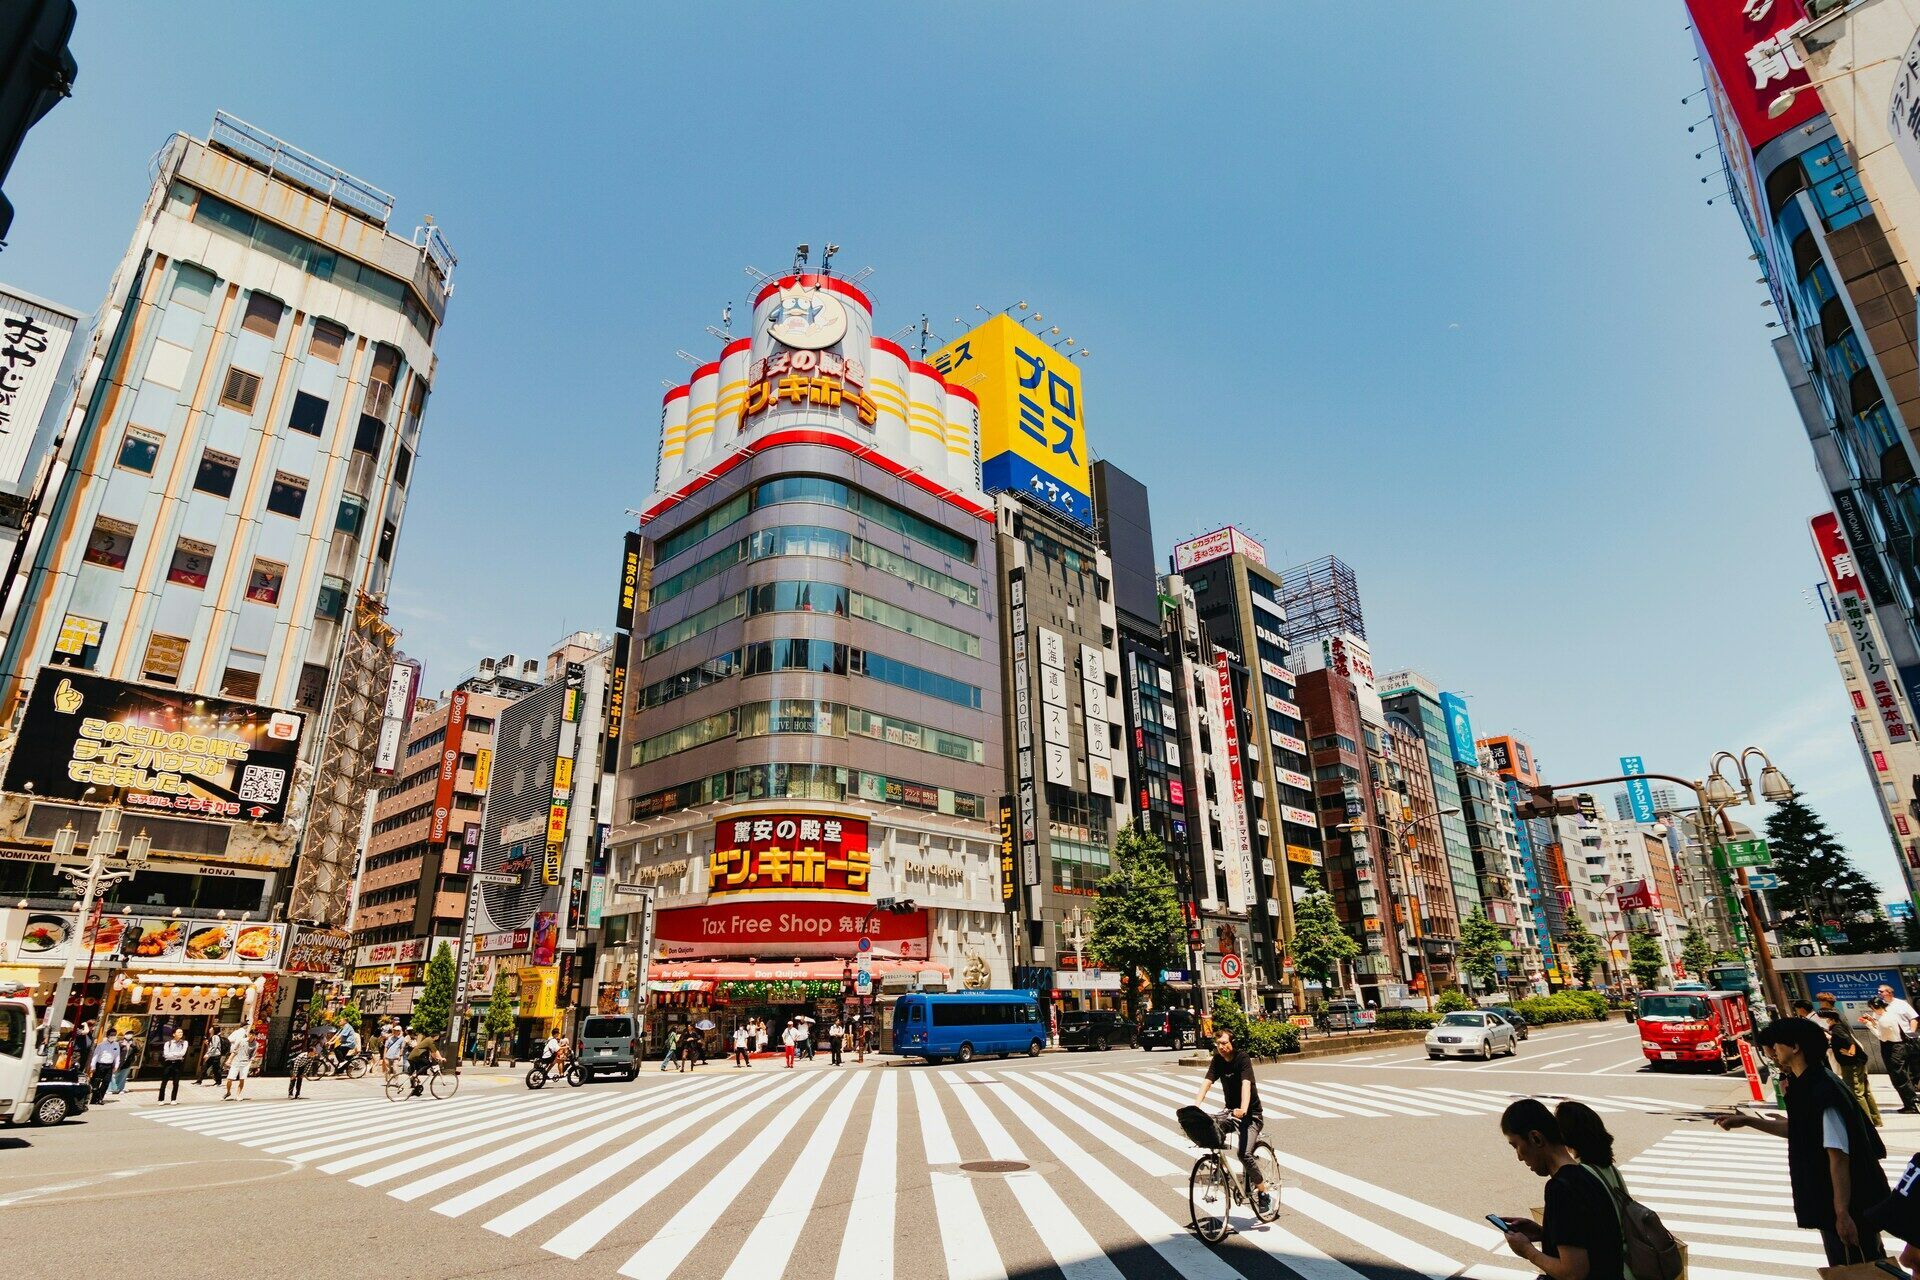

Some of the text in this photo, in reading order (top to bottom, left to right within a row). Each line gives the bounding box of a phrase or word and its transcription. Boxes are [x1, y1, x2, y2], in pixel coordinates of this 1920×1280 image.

[1015, 346, 1076, 420] プロ
[1018, 393, 1080, 467] ミス
[972, 408, 983, 491] Don Quijote
[1846, 512, 1865, 542] WOMAN
[1257, 625, 1291, 650] DARTS
[1843, 597, 1881, 676] 新宿サンパーク
[453, 694, 466, 725] Booth
[1016, 664, 1027, 748] KIBORI
[1046, 636, 1064, 780] 北海道レストラン
[1217, 659, 1232, 706] カラオケ
[1225, 718, 1239, 765] パセラ
[1872, 680, 1907, 738] 三平本館
[79, 717, 250, 761] このビルの8階に
[72, 738, 228, 777] ライブハウスが
[444, 749, 457, 781] Booth
[67, 760, 191, 795] できました。
[434, 807, 448, 840] Booth
[551, 807, 564, 831] 麻雀
[733, 819, 842, 844] 驚安の殿堂
[199, 866, 236, 878] MONJA
[547, 843, 559, 883] CASINO
[904, 859, 964, 879] Don Quijote
[1619, 896, 1644, 910] アコム
[702, 913, 832, 937] Tax Free Shop
[838, 915, 882, 935] 免税店
[754, 970, 773, 978] Don
[1817, 972, 1888, 984] SUBNADE
